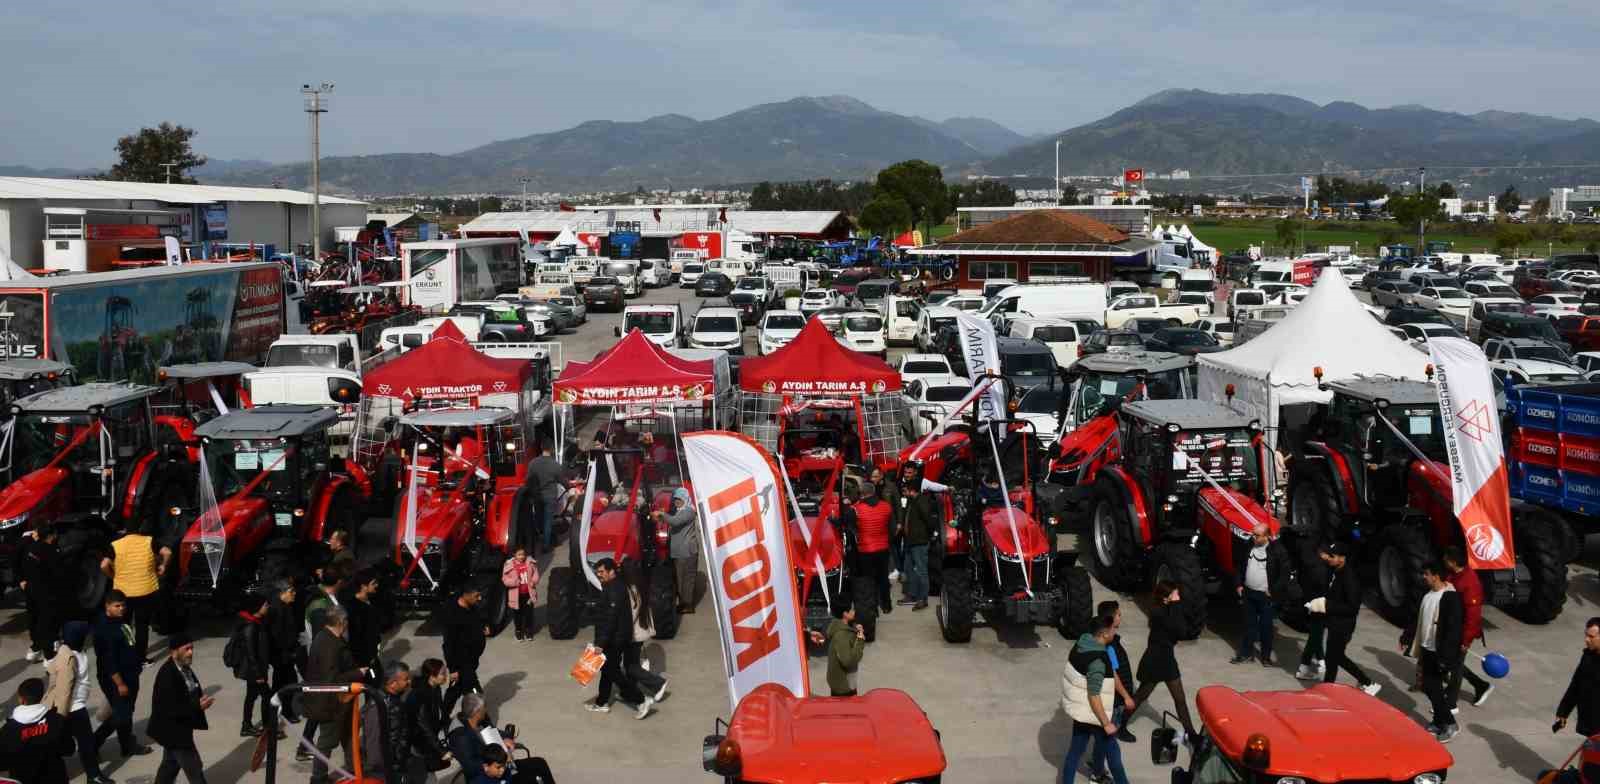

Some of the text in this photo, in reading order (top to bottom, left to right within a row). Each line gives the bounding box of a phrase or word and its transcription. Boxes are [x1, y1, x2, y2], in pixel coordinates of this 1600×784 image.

[415, 386, 441, 394] YDIN
[782, 381, 813, 390] AYDIN
[815, 381, 848, 391] TARIM
[582, 387, 618, 399] AYDIN
[622, 387, 658, 397] TARIM
